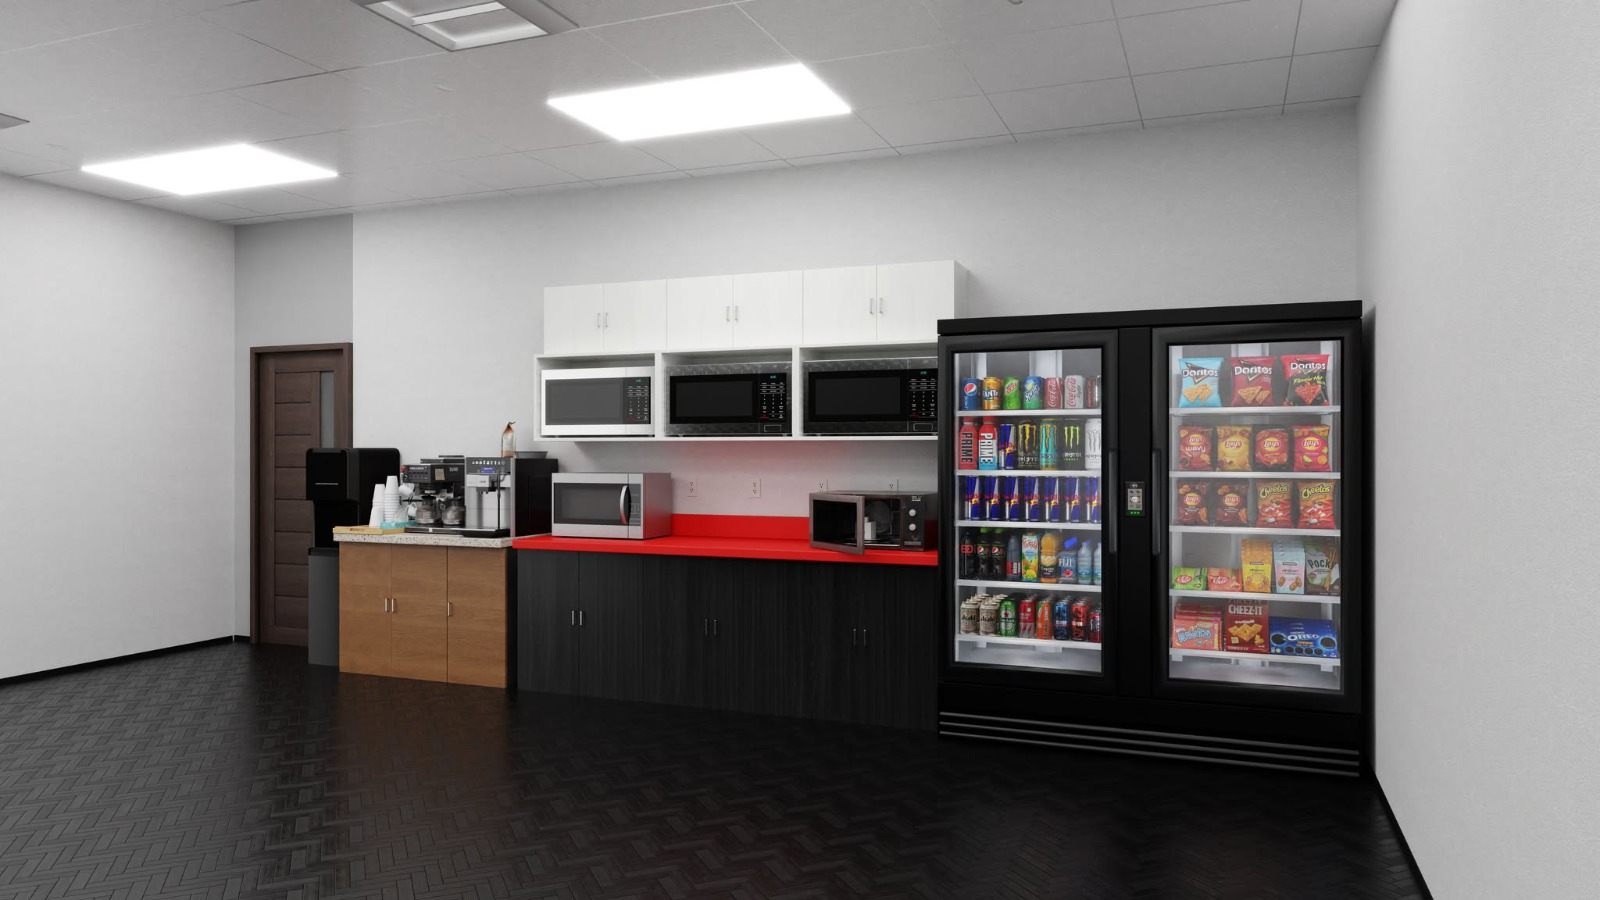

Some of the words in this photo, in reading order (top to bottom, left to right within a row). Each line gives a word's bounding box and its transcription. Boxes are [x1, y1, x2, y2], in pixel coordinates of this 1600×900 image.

[1235, 366, 1272, 375] Doritos
[1291, 362, 1326, 370] Doritos
[1183, 369, 1218, 377] Doritos
[962, 433, 973, 462] PRIME
[981, 433, 994, 464] PRIME
[1260, 485, 1288, 498] Cheetos
[1301, 484, 1330, 499] Cheetos
[1059, 558, 1072, 567] FIJI
[1228, 604, 1263, 616] CHEEZ-IT
[1288, 633, 1319, 641] OREO
